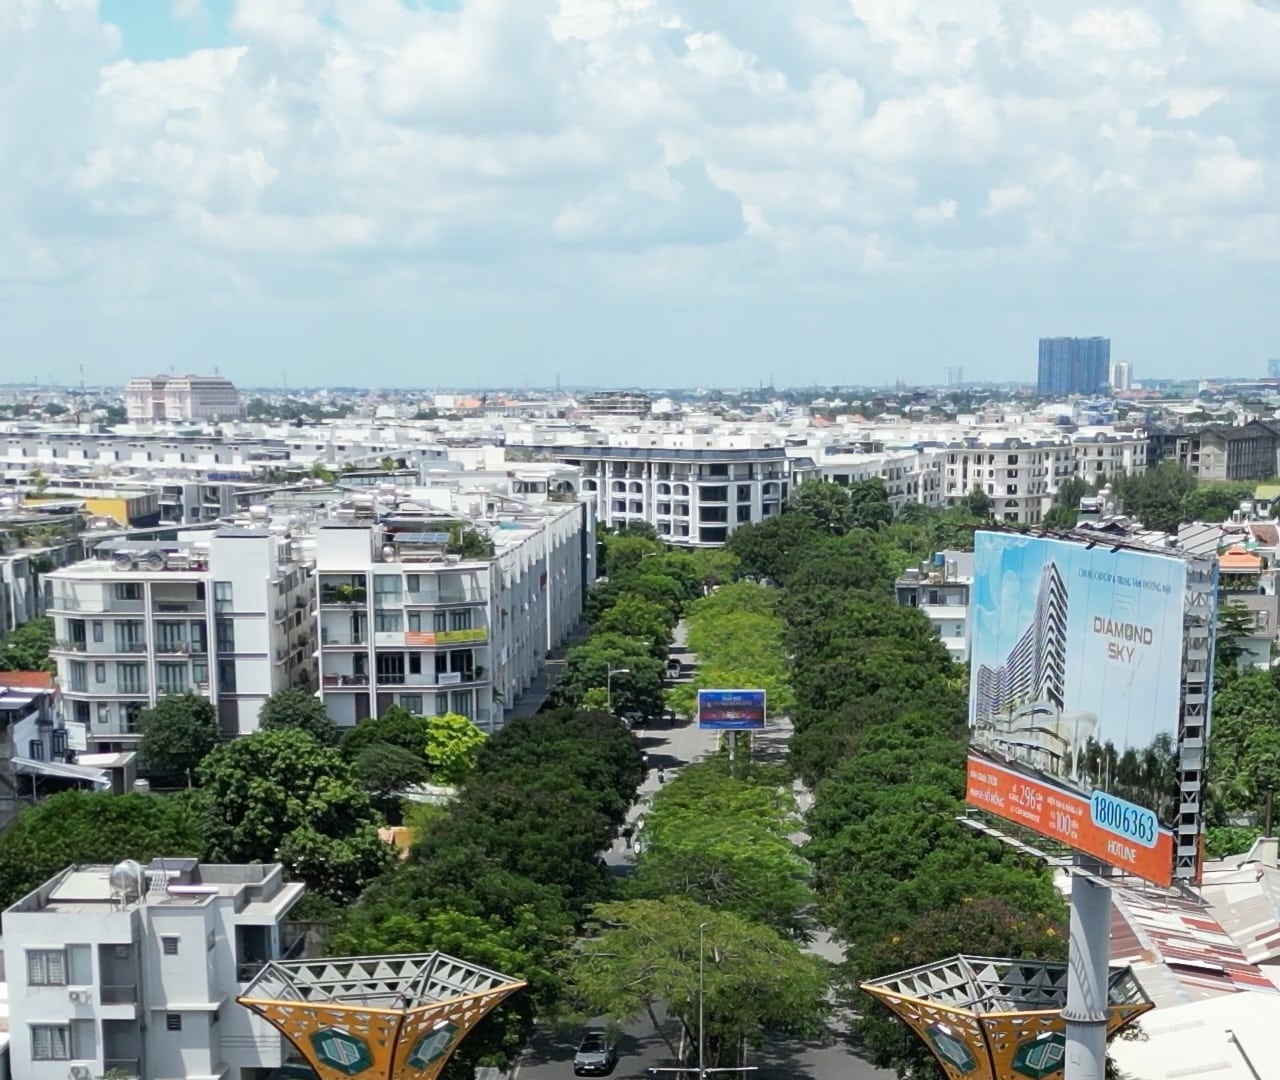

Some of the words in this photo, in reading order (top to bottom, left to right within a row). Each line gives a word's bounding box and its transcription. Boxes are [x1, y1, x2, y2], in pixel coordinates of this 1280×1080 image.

[1093, 616, 1153, 646] DIAMOND
[1108, 642, 1136, 663] SKY
[1019, 785, 1036, 810] 296
[1094, 796, 1154, 842] 18006363
[1107, 839, 1137, 864] HOTLINE
